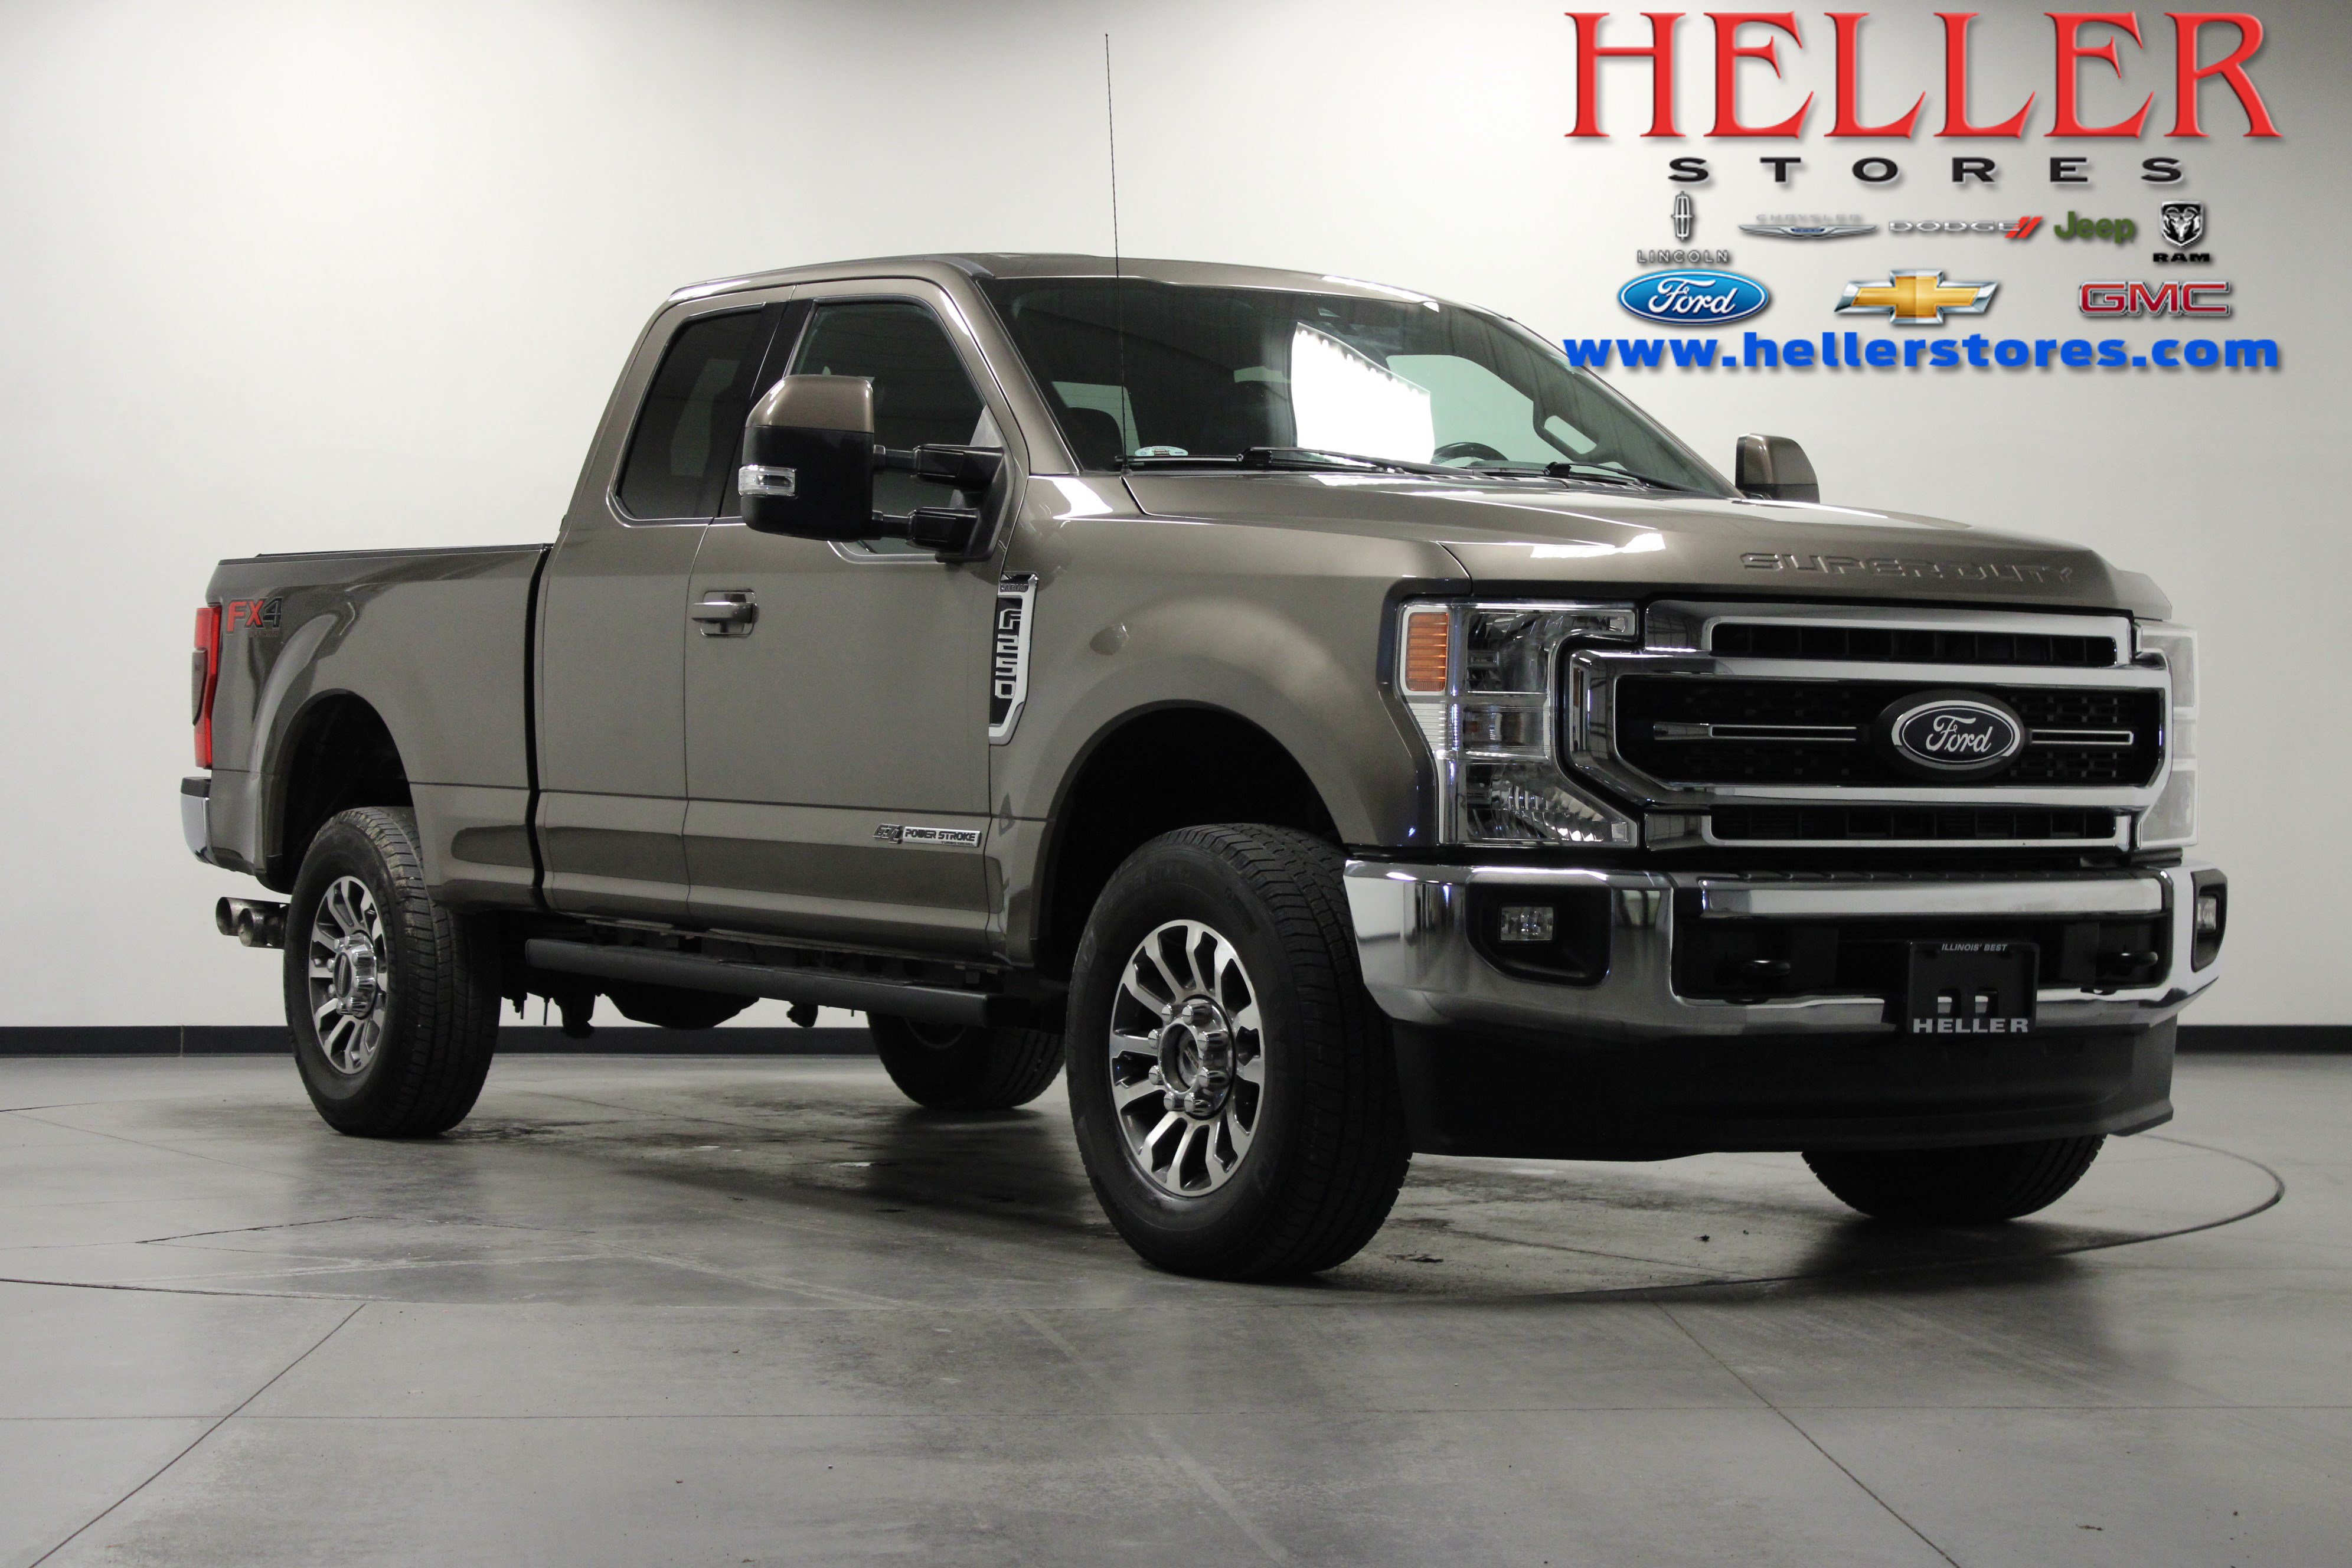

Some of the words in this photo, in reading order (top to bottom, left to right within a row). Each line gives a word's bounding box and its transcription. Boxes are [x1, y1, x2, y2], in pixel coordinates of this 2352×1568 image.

[1000, 583, 1028, 592] LARIAT
[226, 597, 283, 635] FX4
[1926, 714, 1993, 752] Ford
[904, 828, 936, 839] POWER
[937, 831, 976, 842] STROKE
[1941, 943, 1982, 952] ILLINOIS'
[1913, 1018, 2028, 1033] HELLER
